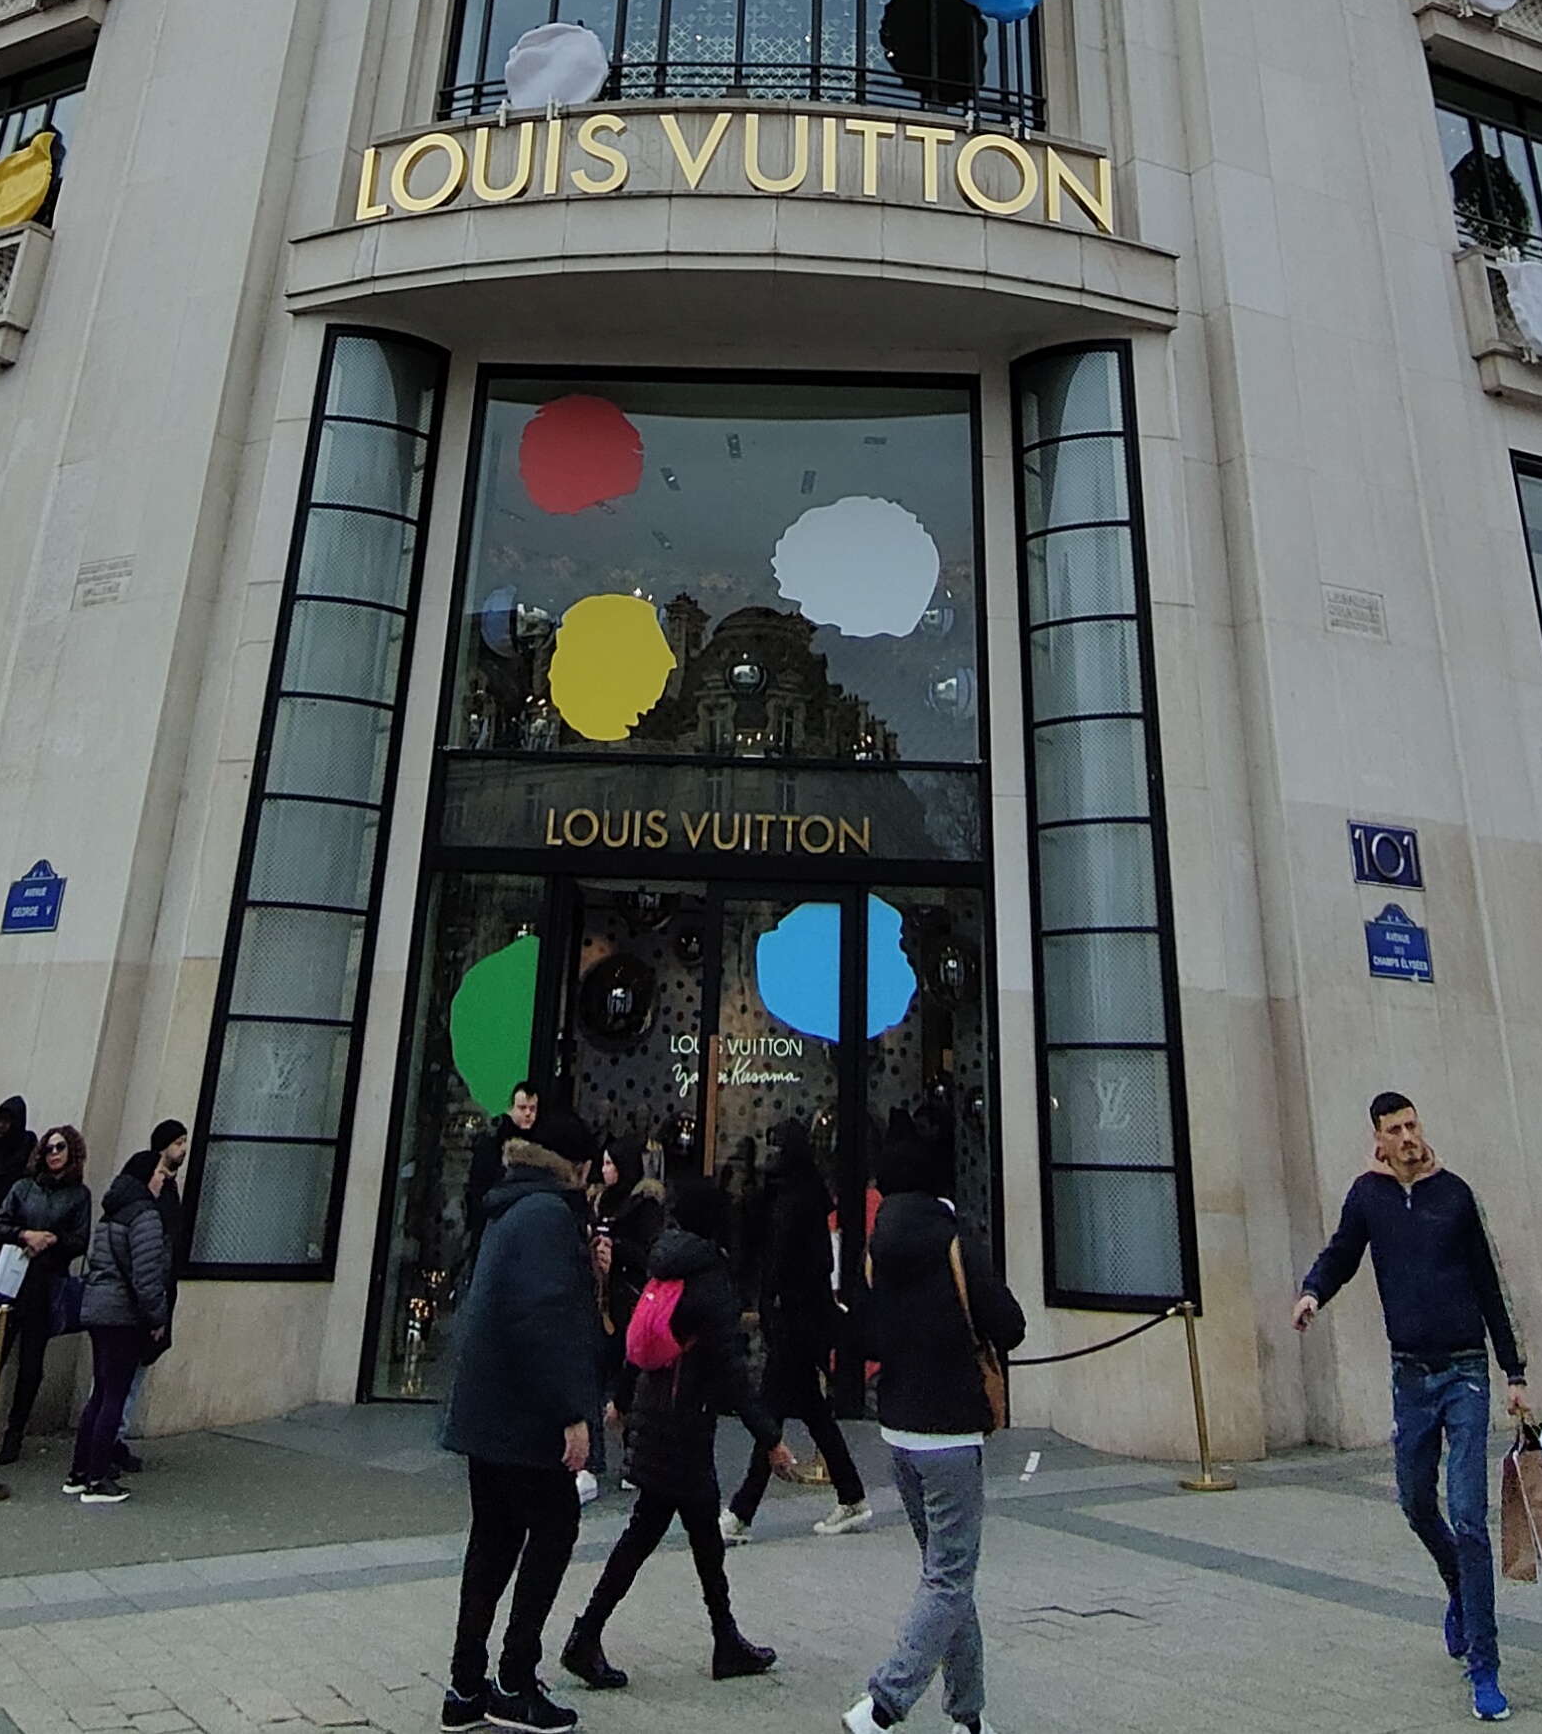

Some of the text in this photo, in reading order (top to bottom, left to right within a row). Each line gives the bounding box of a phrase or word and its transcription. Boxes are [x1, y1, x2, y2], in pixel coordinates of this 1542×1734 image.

[354, 112, 1115, 234] LOUIS VUITTON
[545, 807, 871, 855] LOUIS VUITTON
[1353, 827, 1420, 882] 101
[726, 1037, 803, 1058] VUITTON
[730, 1056, 801, 1086] Kusama
